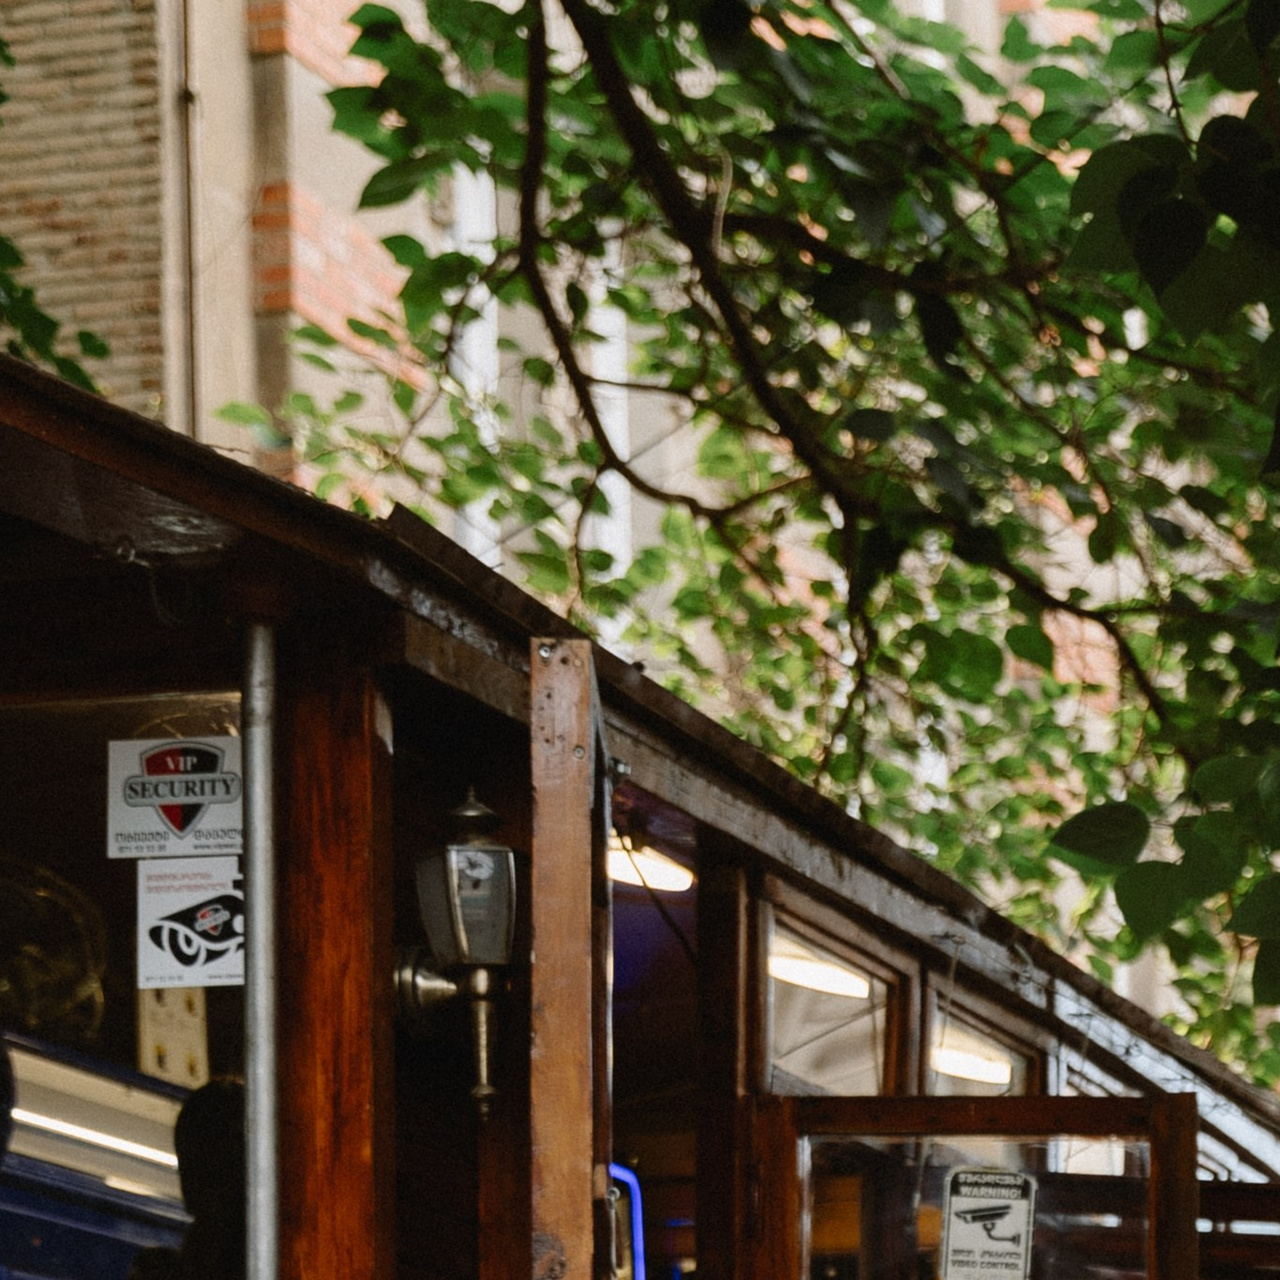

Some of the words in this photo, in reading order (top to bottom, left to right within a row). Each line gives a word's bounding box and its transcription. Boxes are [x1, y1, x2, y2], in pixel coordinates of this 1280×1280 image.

[165, 756, 198, 772] VIP
[126, 777, 235, 800] SECURITY
[960, 1186, 1022, 1199] WARNING!
[951, 1259, 978, 1269] VIDEO
[980, 1260, 1021, 1271] CONTROL
